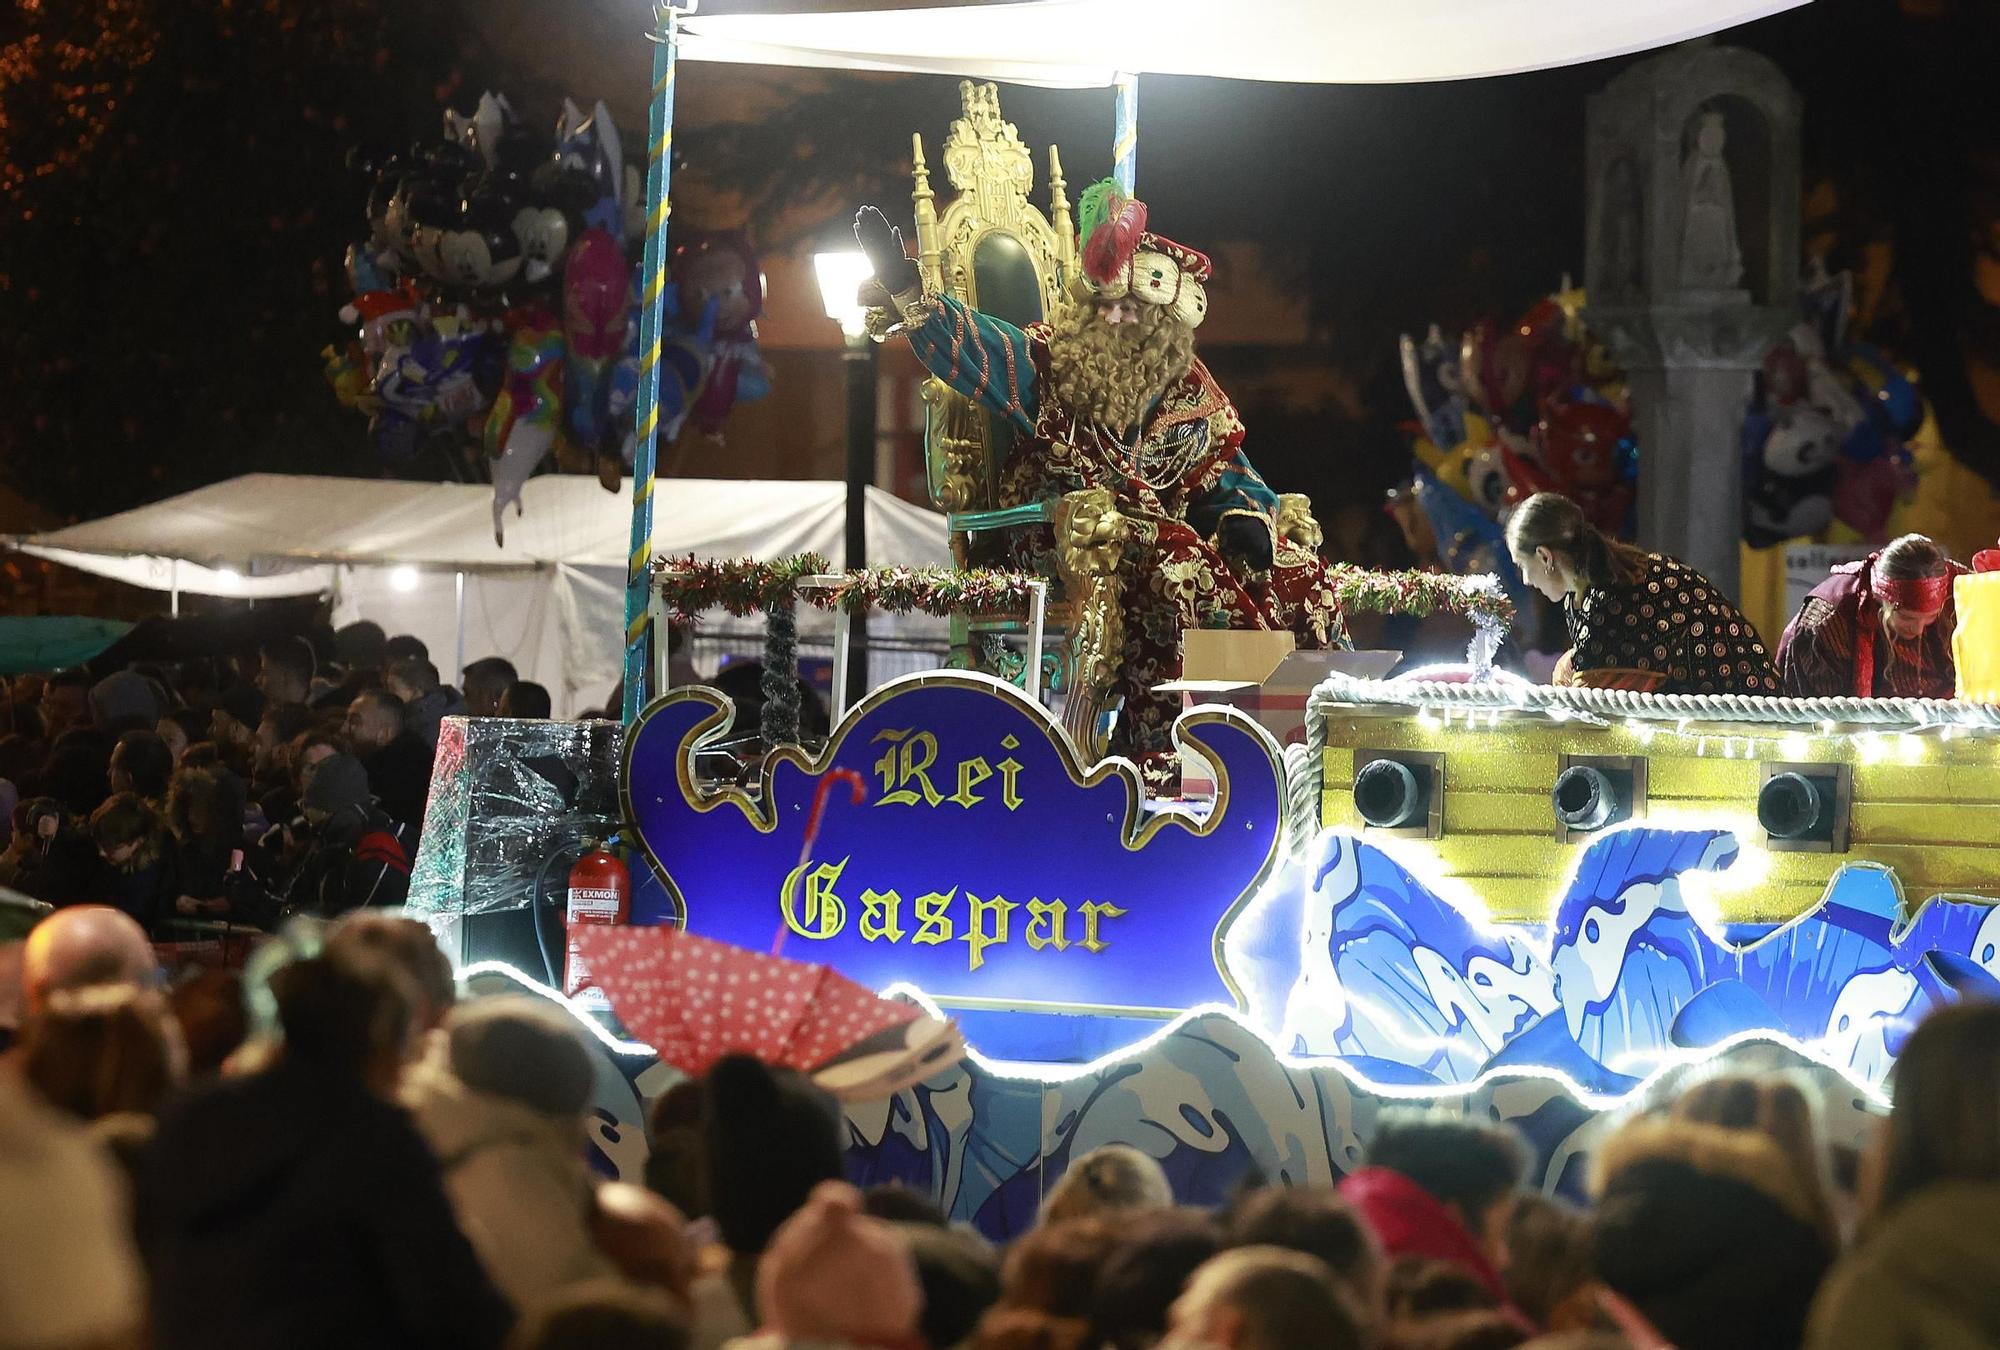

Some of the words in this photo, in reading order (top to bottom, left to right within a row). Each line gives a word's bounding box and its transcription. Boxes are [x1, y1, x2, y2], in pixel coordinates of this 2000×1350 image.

[870, 727, 1024, 811] Rei
[582, 890, 618, 899] EXMON
[780, 855, 1128, 971] Gaspar
